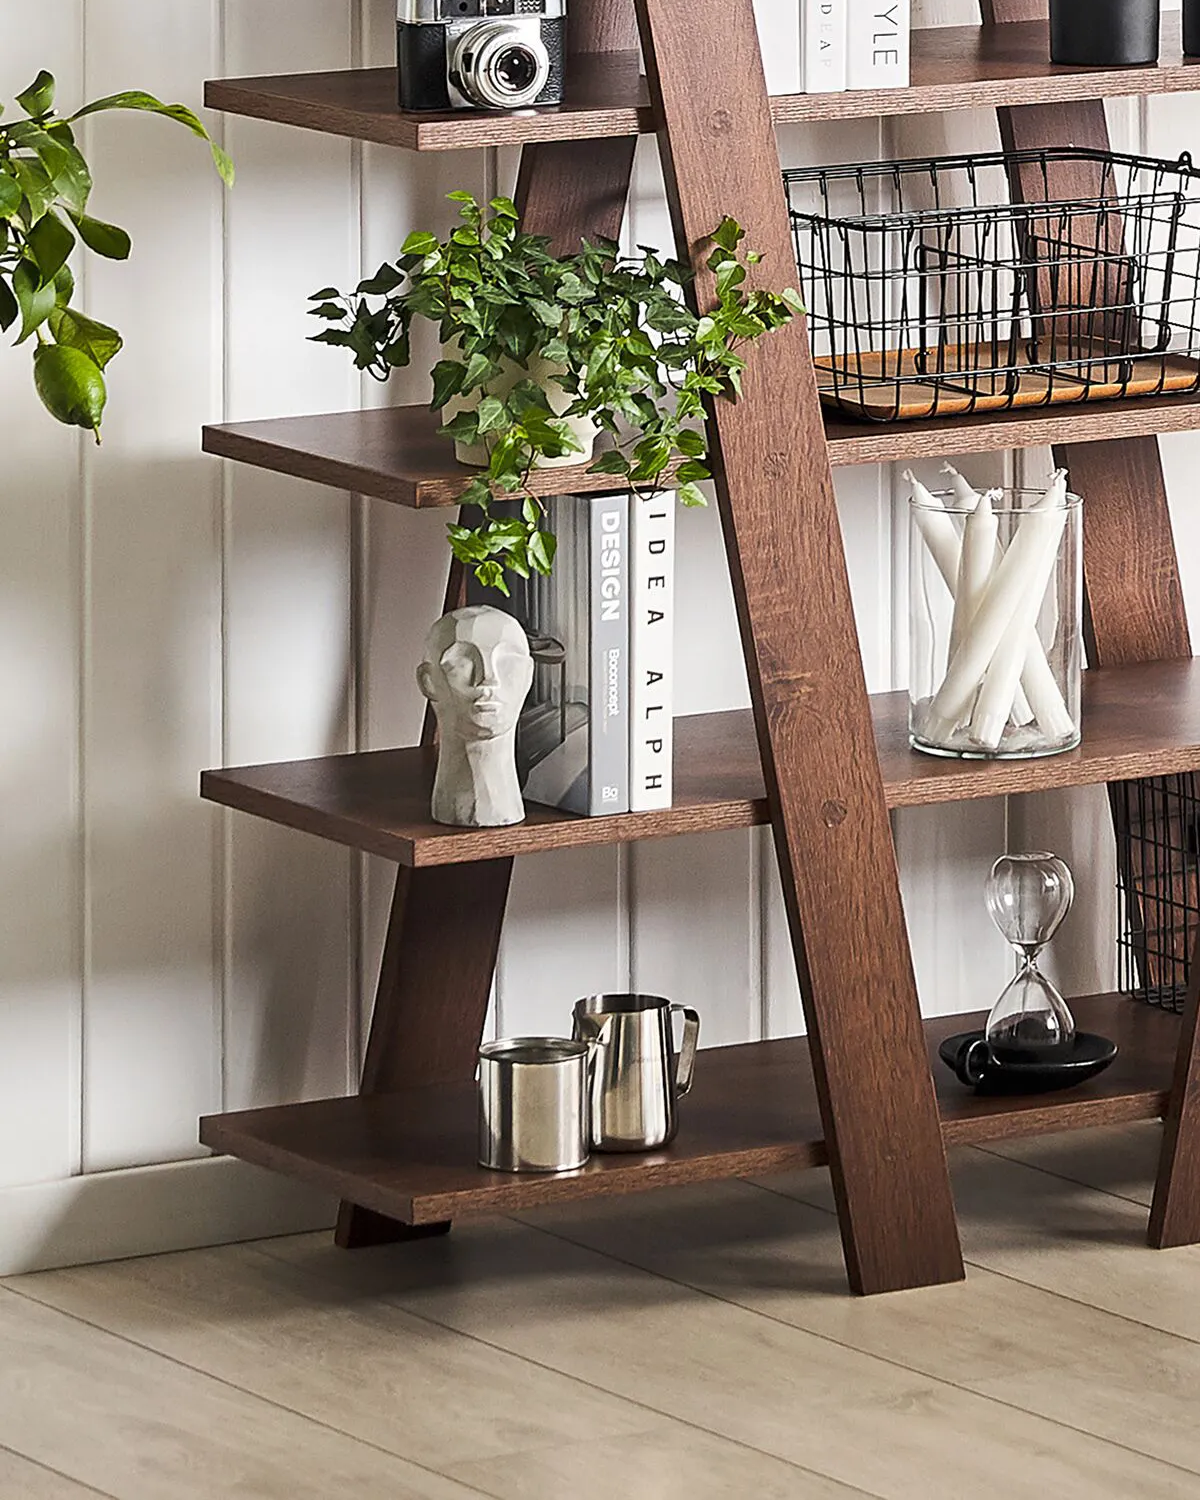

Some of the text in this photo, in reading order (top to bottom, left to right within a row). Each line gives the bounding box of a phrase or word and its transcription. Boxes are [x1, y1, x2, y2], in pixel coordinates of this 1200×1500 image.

[601, 511, 621, 621] DESIGN
[645, 512, 667, 791] IDEA ALPH
